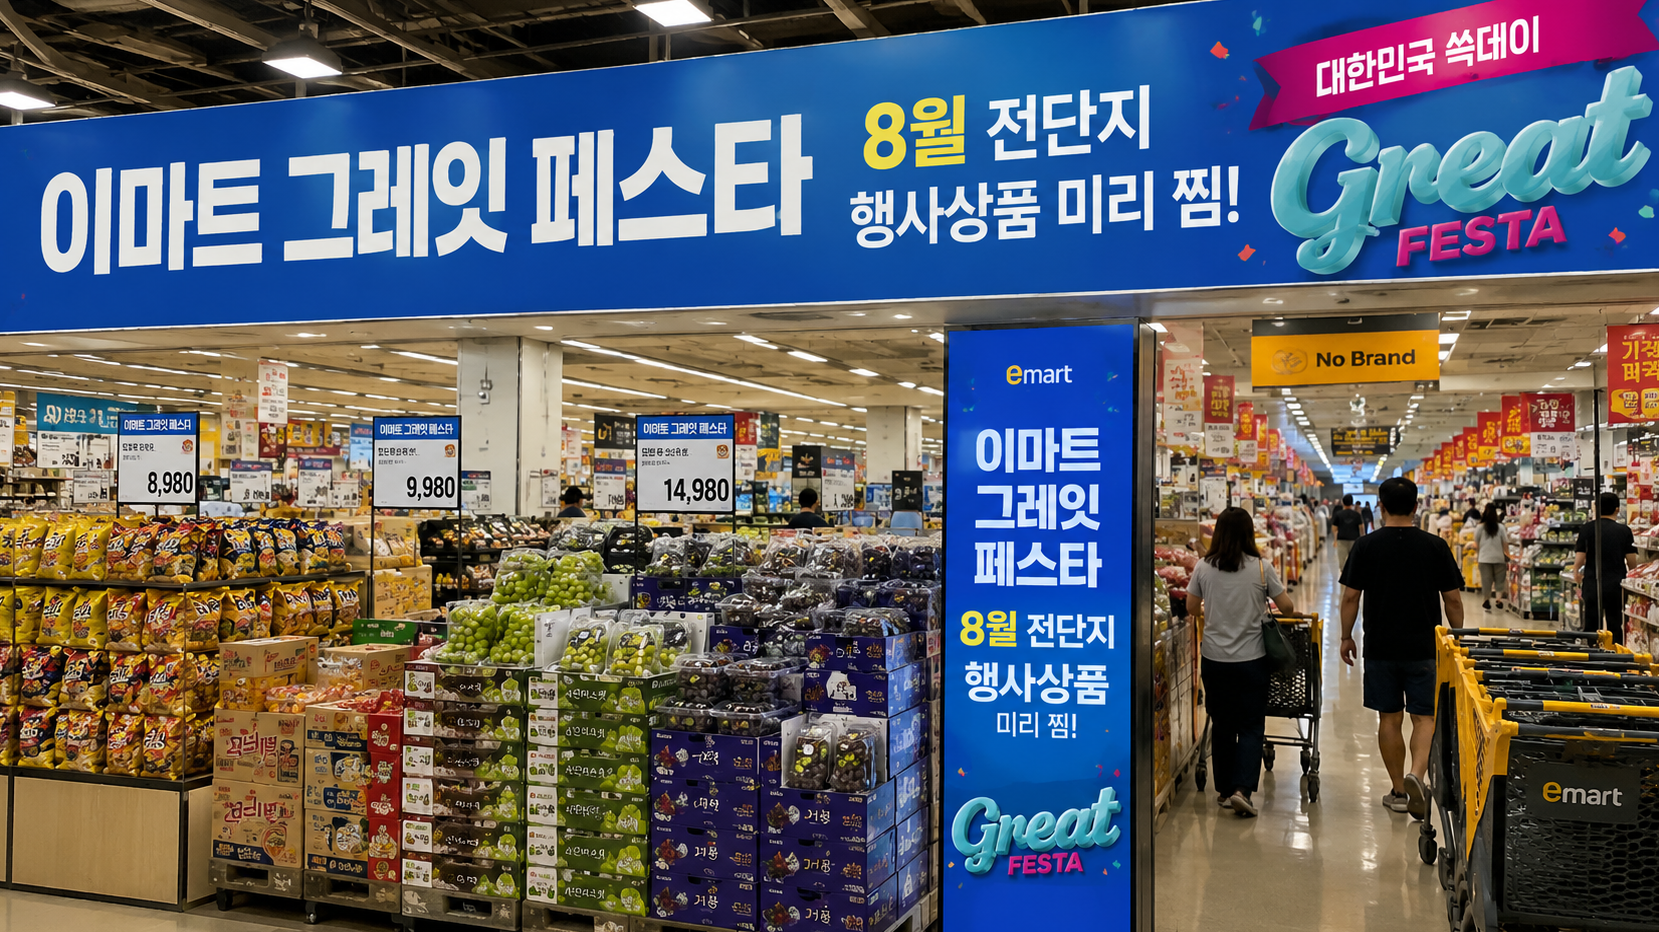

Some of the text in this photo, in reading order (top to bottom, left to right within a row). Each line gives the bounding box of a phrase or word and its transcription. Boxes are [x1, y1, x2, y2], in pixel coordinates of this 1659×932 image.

[1316, 15, 1539, 98] 대한민국 쓱데이
[864, 84, 1150, 170] 8월 전단지
[1271, 65, 1653, 275] Great
[40, 113, 814, 275] 이마트 그레잇 페스타
[849, 165, 1239, 249] 행사상품 미리 찜!
[1396, 205, 1567, 267] FESTA
[1006, 364, 1073, 385] emart
[1316, 349, 1416, 368] No Brand
[976, 427, 1101, 473] 이마트
[147, 471, 194, 498] 8,980
[406, 476, 456, 502] 9,980
[663, 477, 730, 506] 14,980
[975, 484, 1101, 531] 그레잇
[974, 541, 1103, 588] 페스타
[960, 610, 1115, 650] 8월 전단지
[965, 661, 1109, 705] 행사상품
[997, 711, 1078, 739] 미리 찜!
[1542, 781, 1623, 807] emart
[952, 787, 1122, 874] Great
[1007, 852, 1084, 875] FESTA
